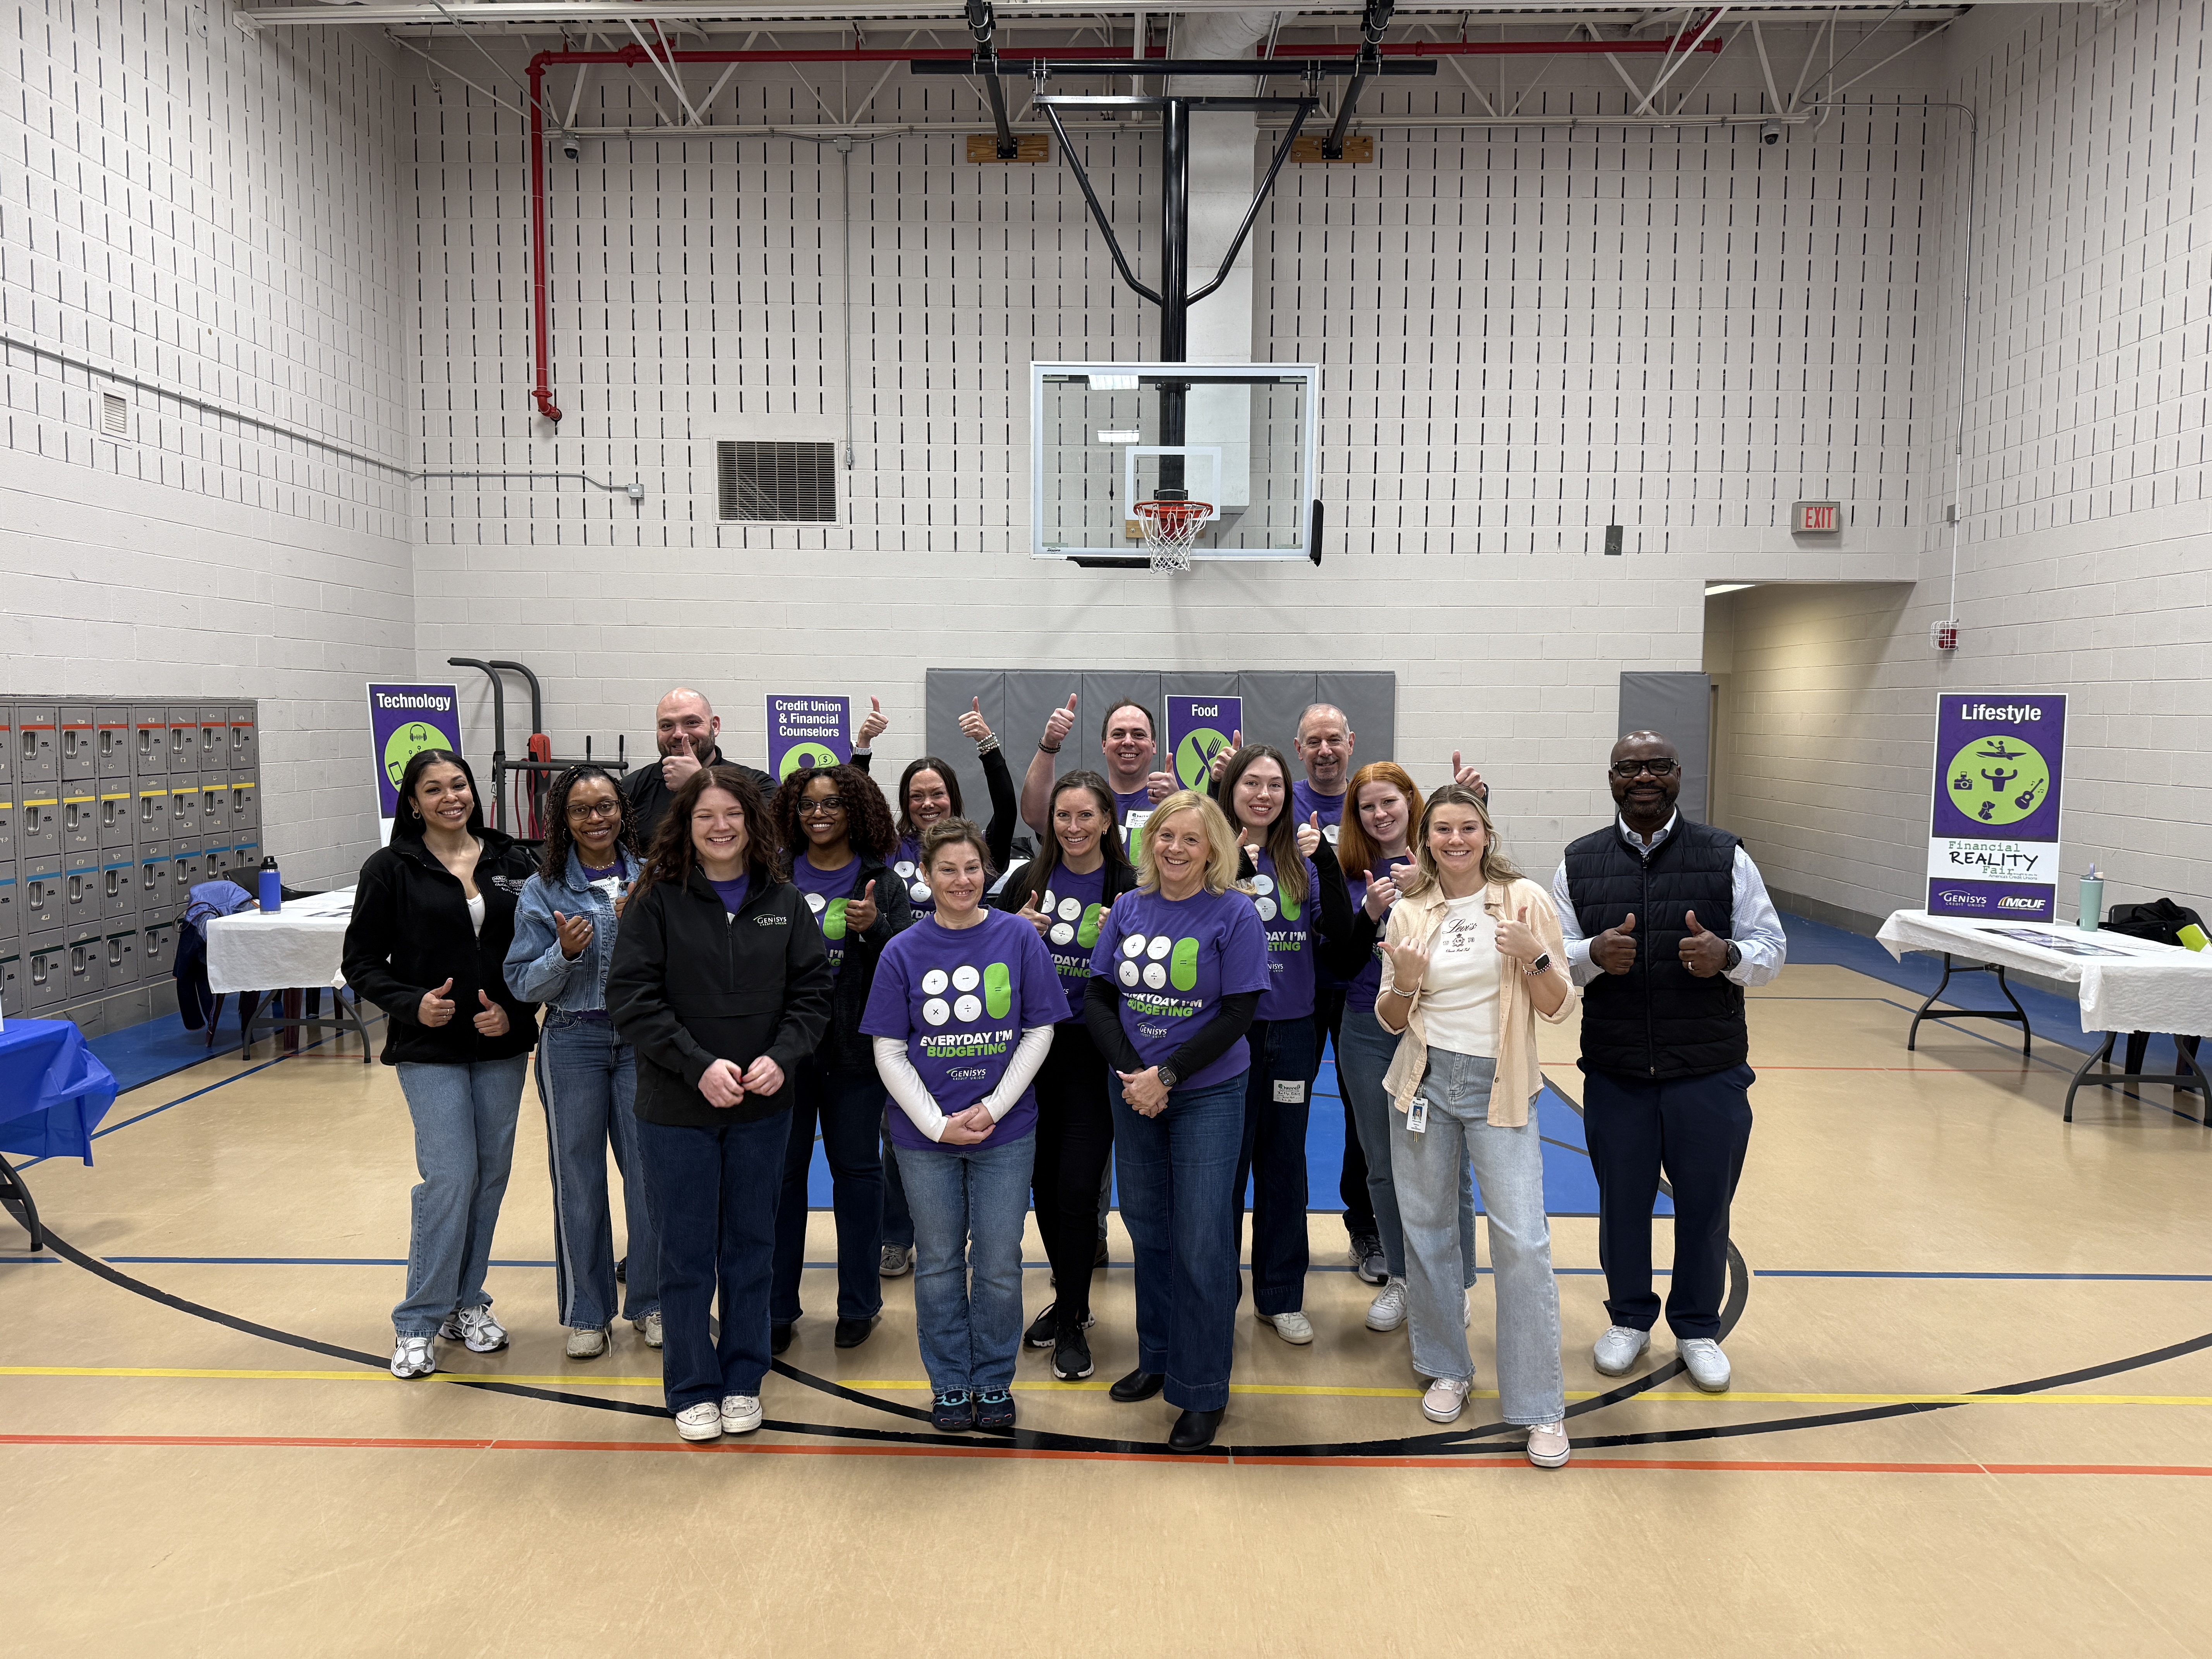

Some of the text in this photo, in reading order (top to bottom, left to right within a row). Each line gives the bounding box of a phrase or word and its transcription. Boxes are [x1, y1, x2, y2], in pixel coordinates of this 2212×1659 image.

[1805, 507, 1833, 528] EXIT
[376, 693, 451, 711] Technology
[776, 700, 841, 712] Credit Union
[1192, 704, 1218, 717] Food
[1962, 704, 2042, 724] Lifestyle
[779, 713, 839, 724] & Financial
[779, 726, 840, 737] Counselors
[1949, 840, 2020, 852] Financial
[1949, 851, 2039, 871] REALITY
[1982, 866, 2014, 875] Fair
[2005, 898, 2046, 908] MCUF
[1290, 931, 1306, 941] I'M
[1268, 941, 1301, 951] ETING
[1056, 964, 1091, 978] ETING
[920, 1029, 1013, 1046] EVERYDAY I'M
[927, 1042, 1006, 1058] BUDGETING
